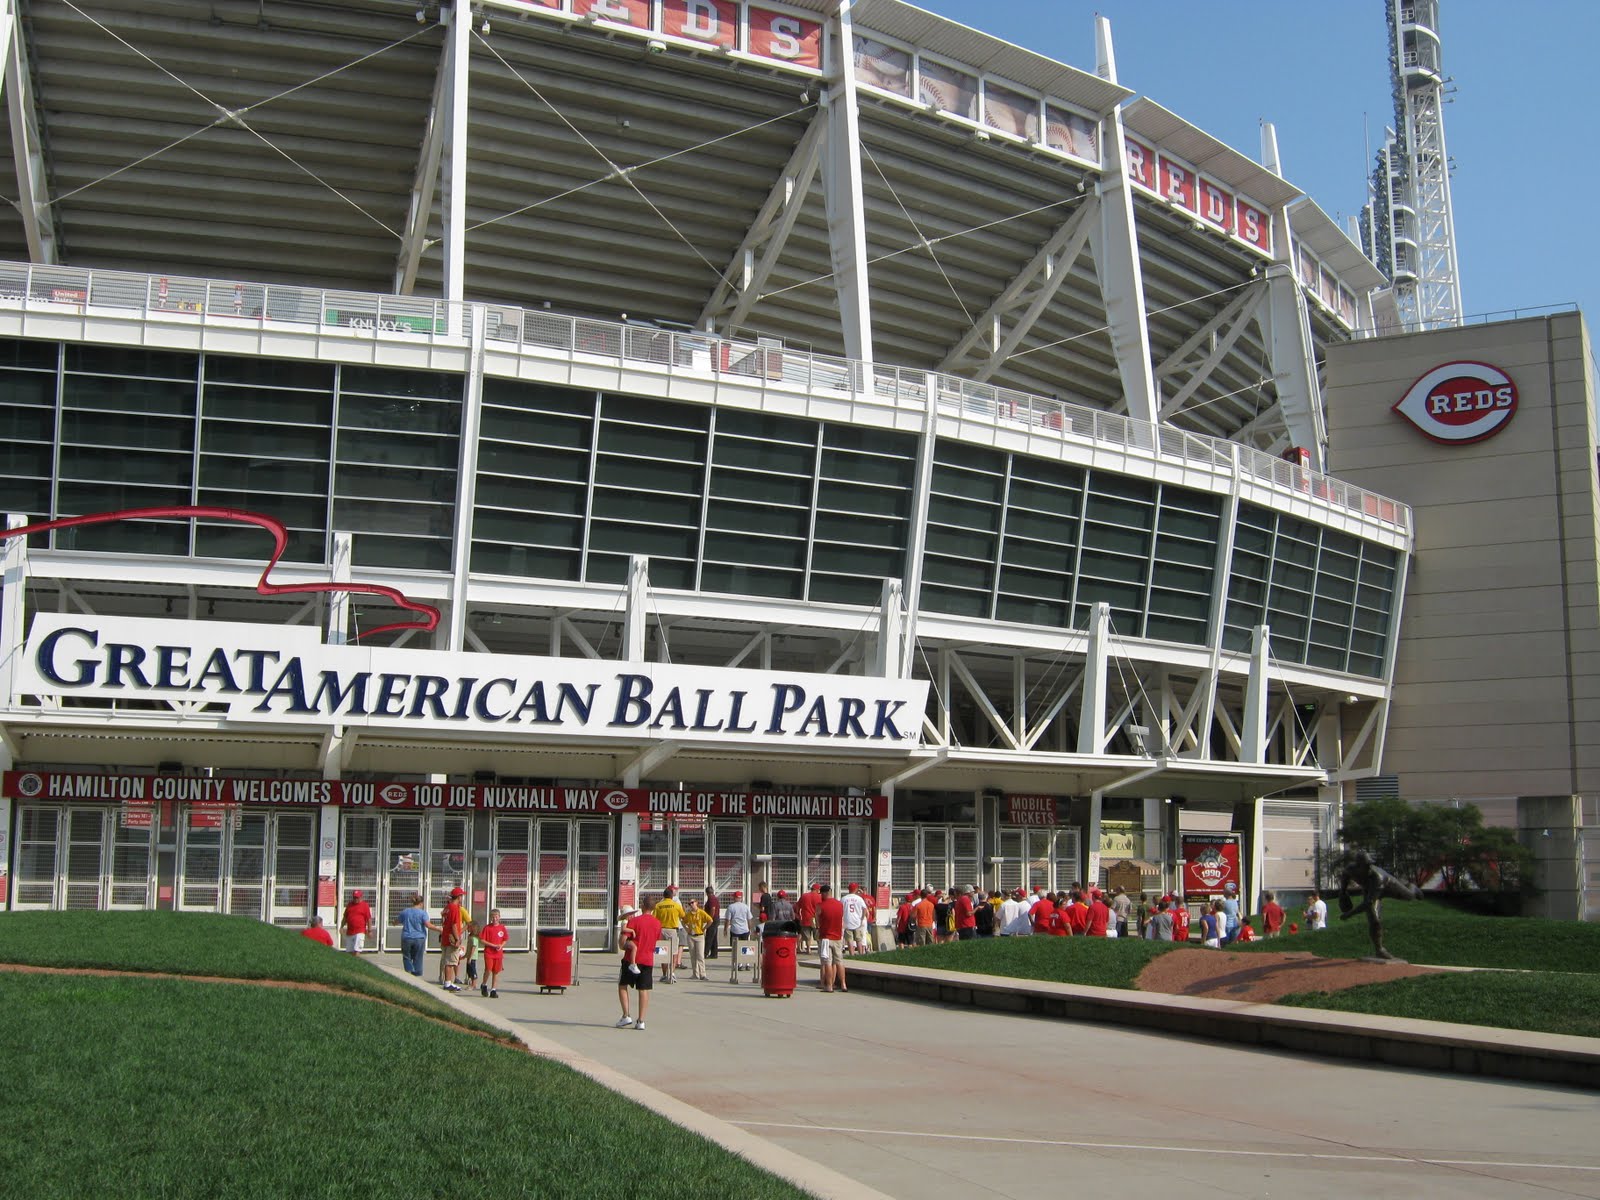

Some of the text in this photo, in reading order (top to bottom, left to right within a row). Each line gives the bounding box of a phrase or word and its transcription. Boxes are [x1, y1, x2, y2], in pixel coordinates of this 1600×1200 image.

[1126, 144, 1260, 243] REDS
[1430, 387, 1513, 414] REDS
[607, 673, 758, 733] BALL
[764, 682, 909, 740] PARK
[49, 774, 874, 818] HAMILTON COUNTY WELCOMES YOU 100 JOE NUXHALL WAY HOME OF THE CINCINNATI REDS
[1011, 797, 1052, 811] MOBILE
[1010, 810, 1055, 825] TICKETS
[1201, 869, 1221, 878] 1990
[849, 903, 855, 913] 5
